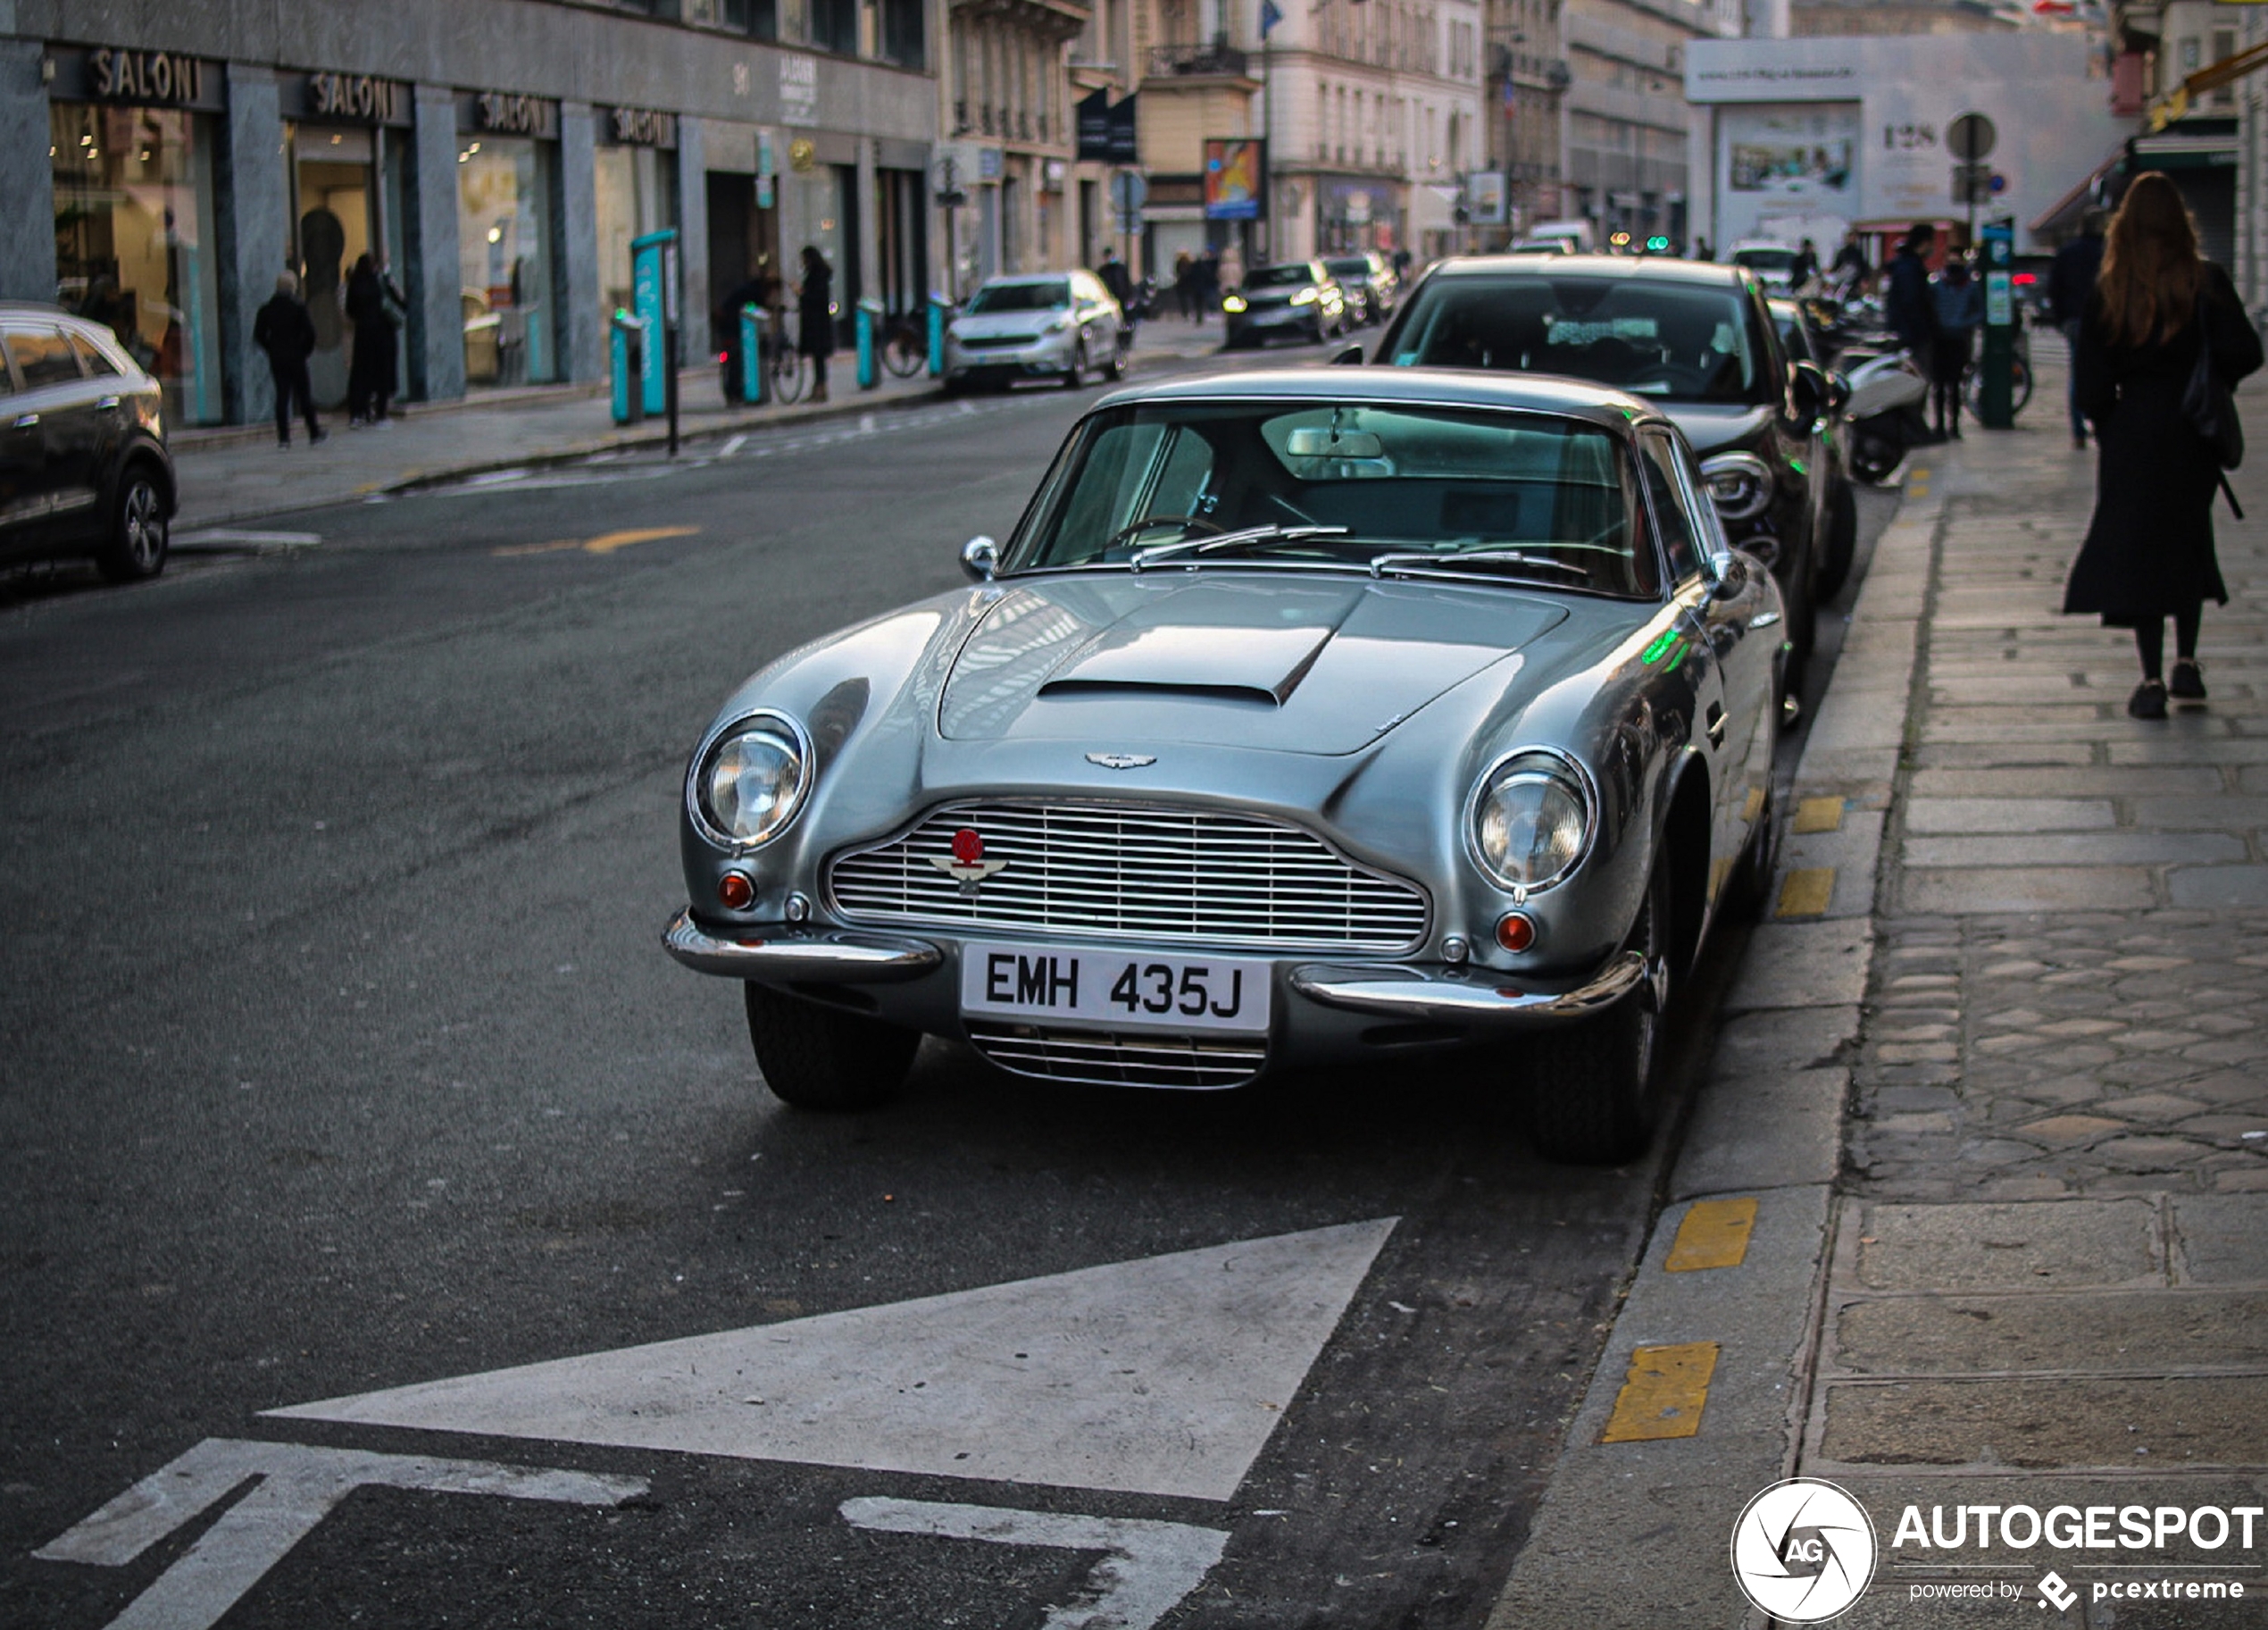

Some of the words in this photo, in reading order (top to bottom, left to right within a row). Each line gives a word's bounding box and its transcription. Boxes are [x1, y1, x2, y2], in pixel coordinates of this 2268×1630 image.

[93, 48, 203, 103] SALONI
[313, 71, 397, 121] SALONI
[482, 93, 550, 133] SALONI
[1883, 123, 1937, 149] 128
[987, 953, 1079, 1007] EMH
[1111, 964, 1242, 1017] 435J
